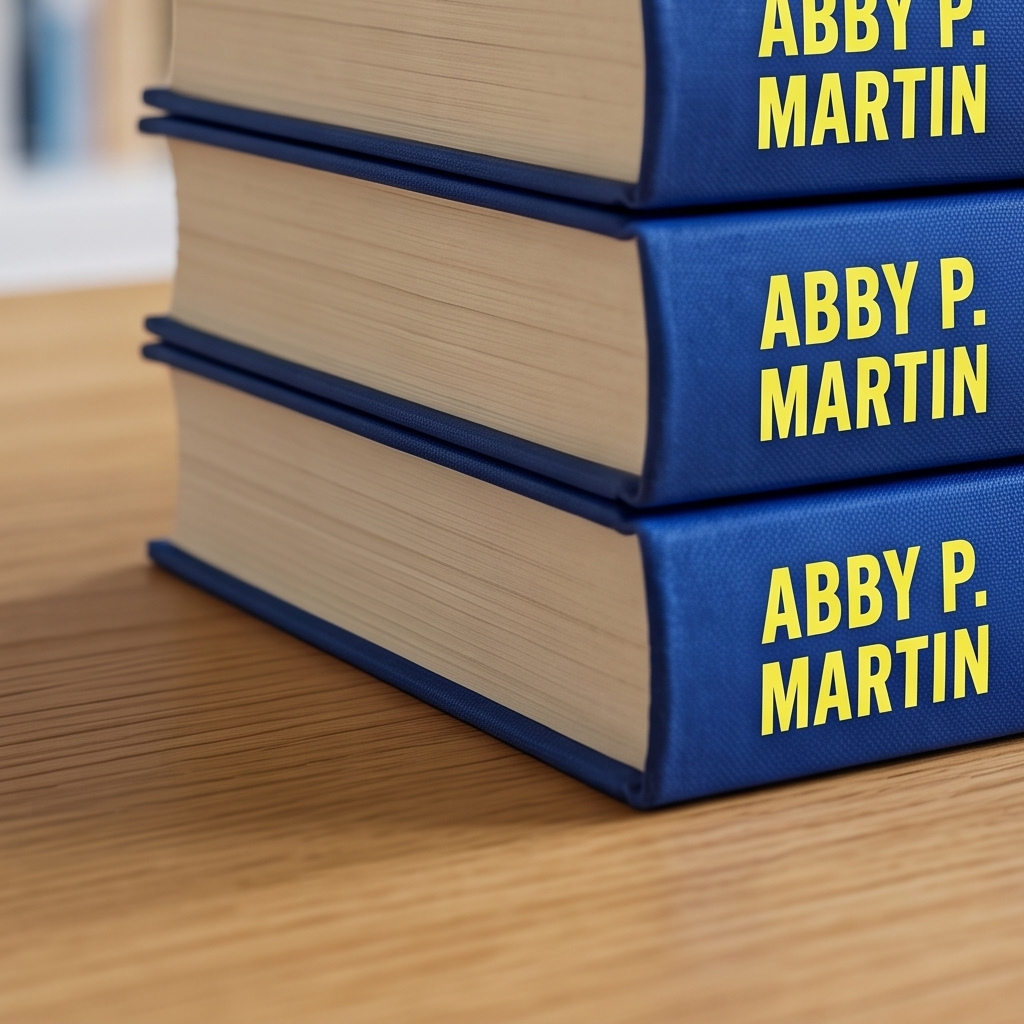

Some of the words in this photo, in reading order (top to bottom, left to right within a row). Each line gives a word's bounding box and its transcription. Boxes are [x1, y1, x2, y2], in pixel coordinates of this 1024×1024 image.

[758, 64, 986, 149] MARTIN
[760, 261, 918, 349] ABBY
[940, 257, 985, 329] P.
[761, 344, 987, 441] MARTIN
[762, 546, 920, 644] ABBY
[942, 540, 986, 613] P.
[762, 625, 988, 736] MARTIN
